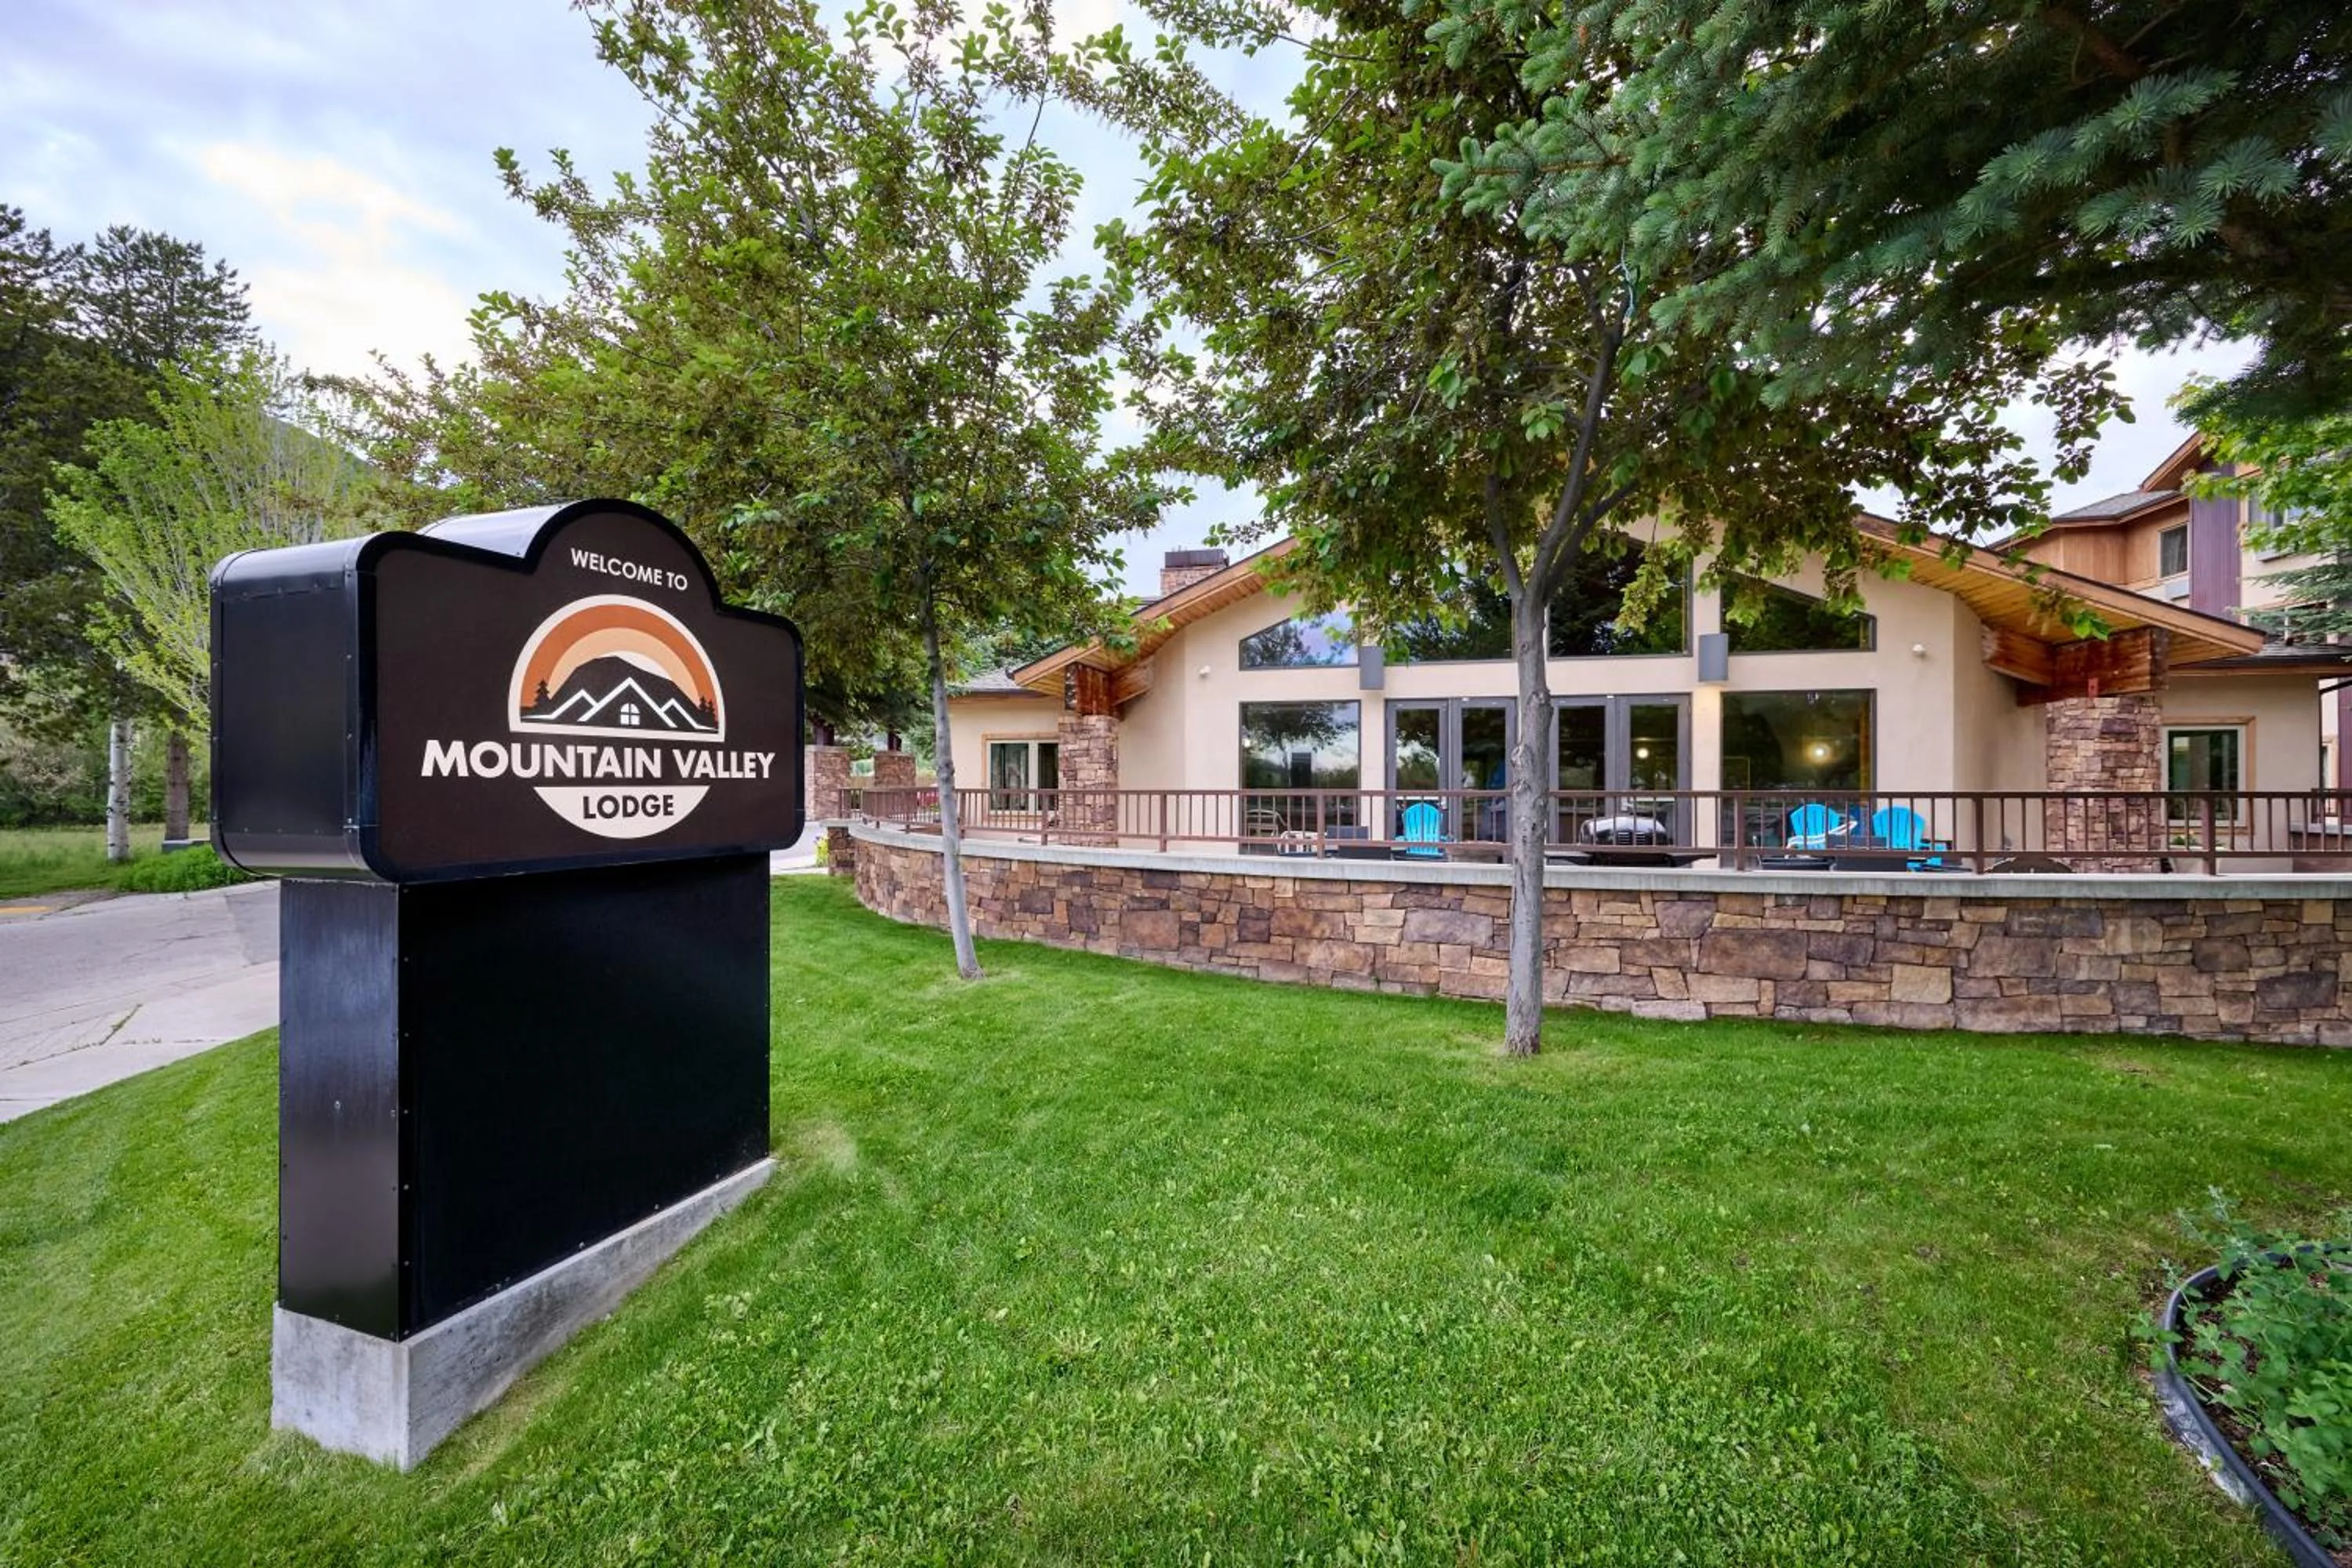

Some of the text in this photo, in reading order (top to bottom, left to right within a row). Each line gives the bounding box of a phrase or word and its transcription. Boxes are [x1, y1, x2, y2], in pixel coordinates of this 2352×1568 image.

[571, 548, 688, 591] WELCOME TO
[421, 739, 776, 779] MOUNTAIN VALLEY
[583, 793, 674, 820] LODGE
